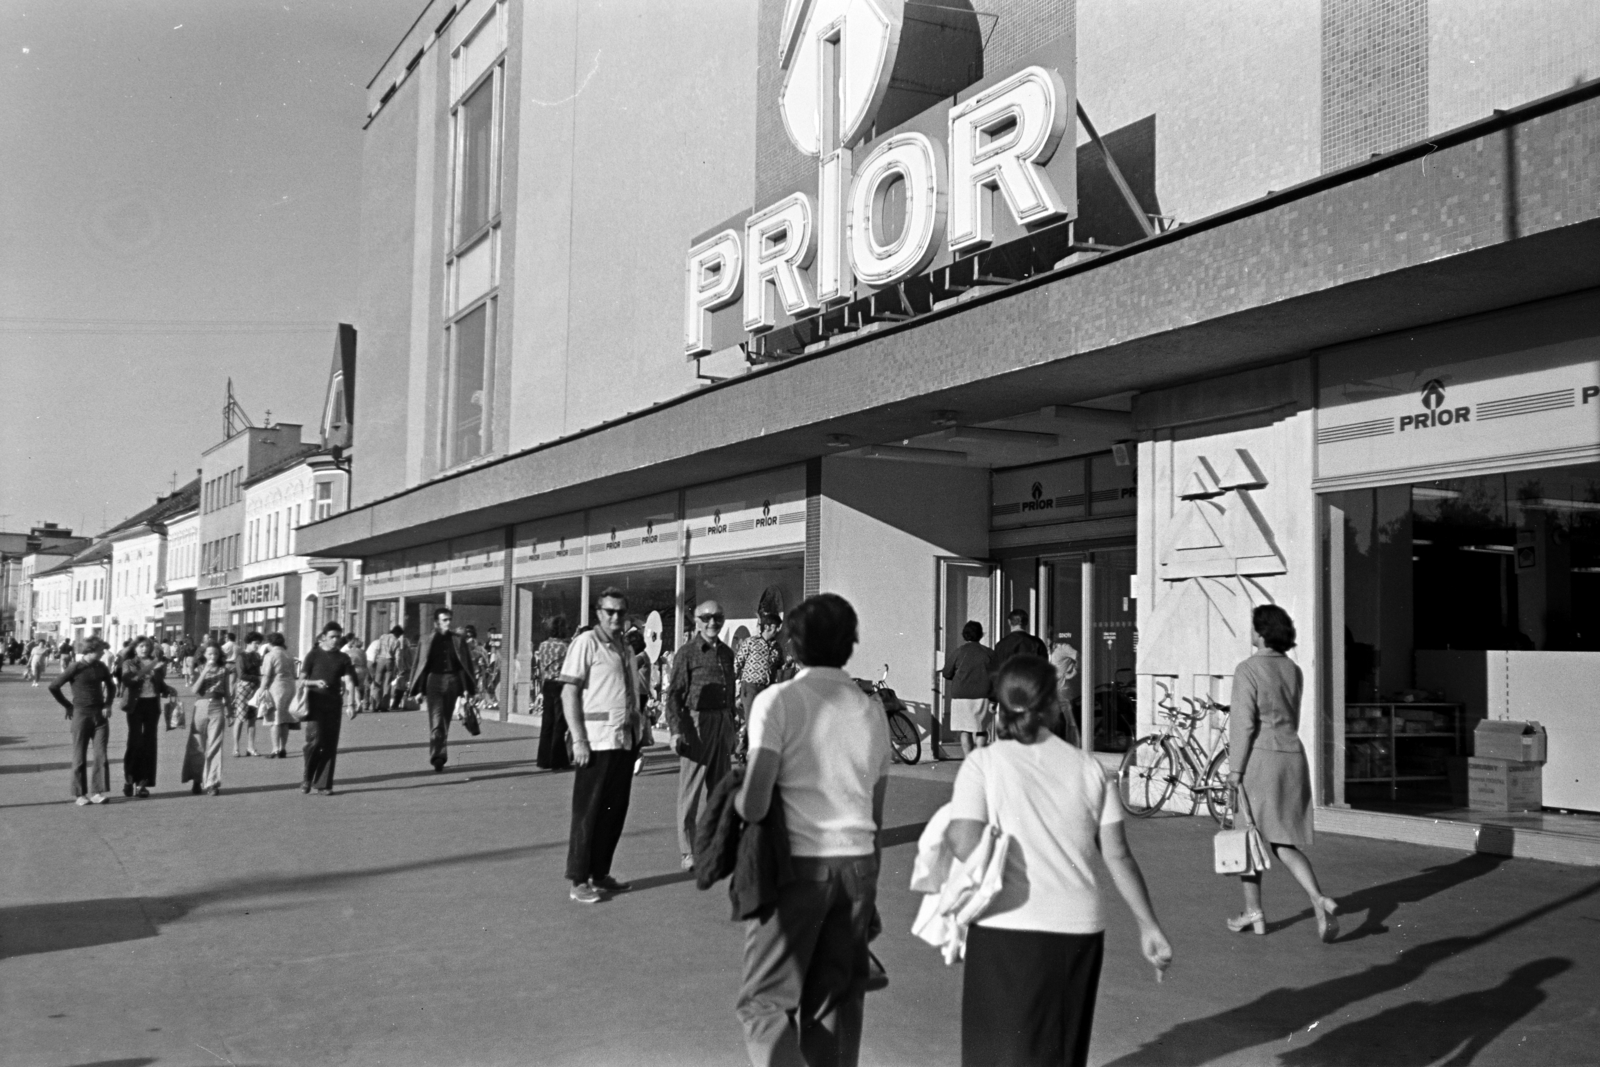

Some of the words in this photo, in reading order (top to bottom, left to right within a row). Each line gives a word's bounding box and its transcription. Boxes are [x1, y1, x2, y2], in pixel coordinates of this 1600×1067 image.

[685, 65, 1068, 356] PRIOR
[1400, 406, 1470, 431] PRIOR
[1022, 499, 1053, 512] PRIOR
[755, 516, 777, 528] PRIOR
[707, 524, 727, 535] PRIOR
[606, 541, 621, 550] PRIOR
[642, 535, 658, 544] PRIOR
[230, 581, 280, 606] DROGÉRIA
